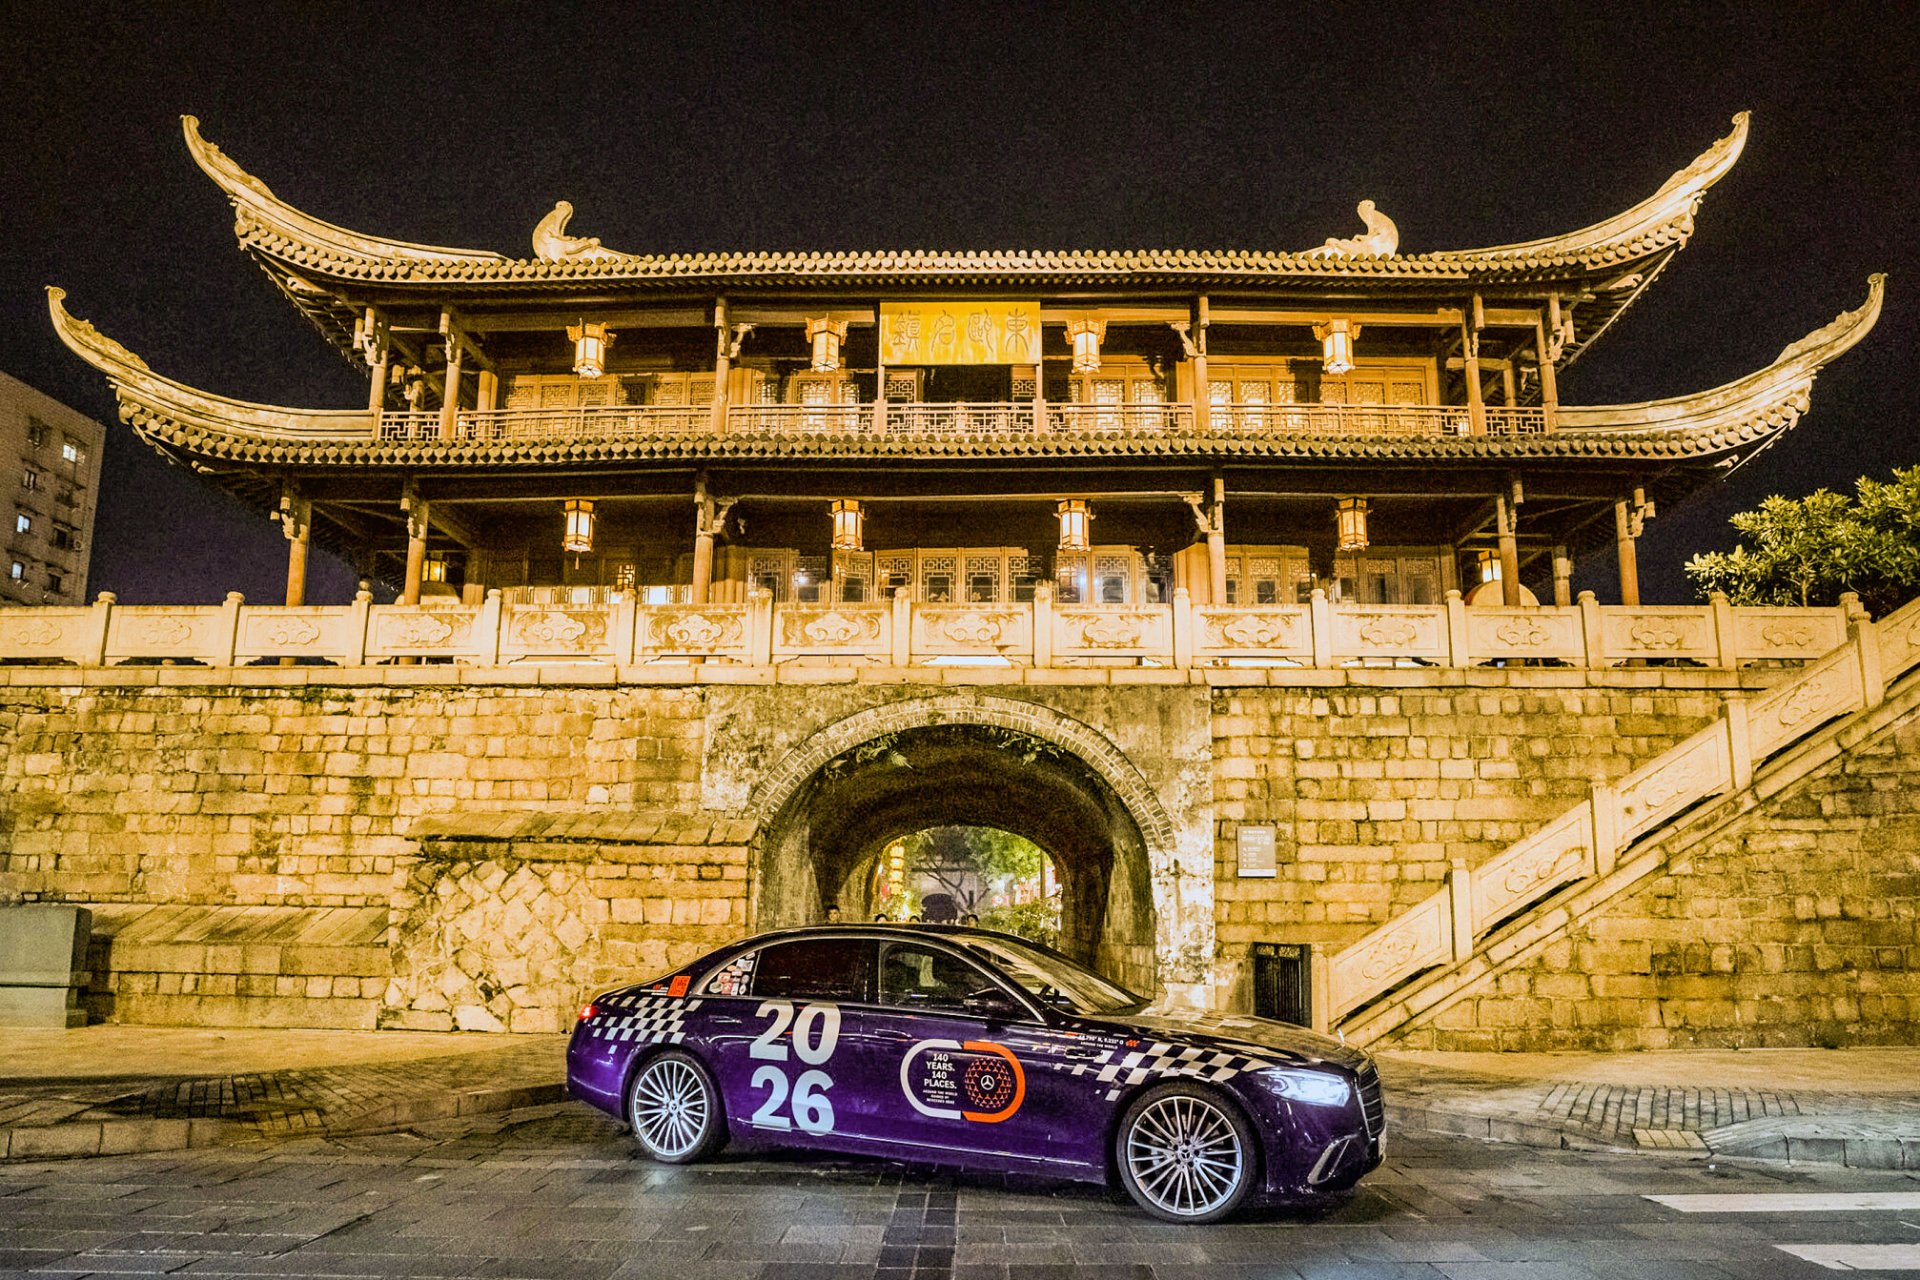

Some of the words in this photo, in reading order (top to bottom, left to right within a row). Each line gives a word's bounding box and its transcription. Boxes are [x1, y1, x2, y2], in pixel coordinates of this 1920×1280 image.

[750, 1000, 842, 1065] 20
[933, 1053, 949, 1062] 140
[926, 1061, 955, 1072] YEARS.
[932, 1070, 947, 1079] 140
[924, 1078, 957, 1089] PLACES.
[750, 1065, 835, 1136] 26
